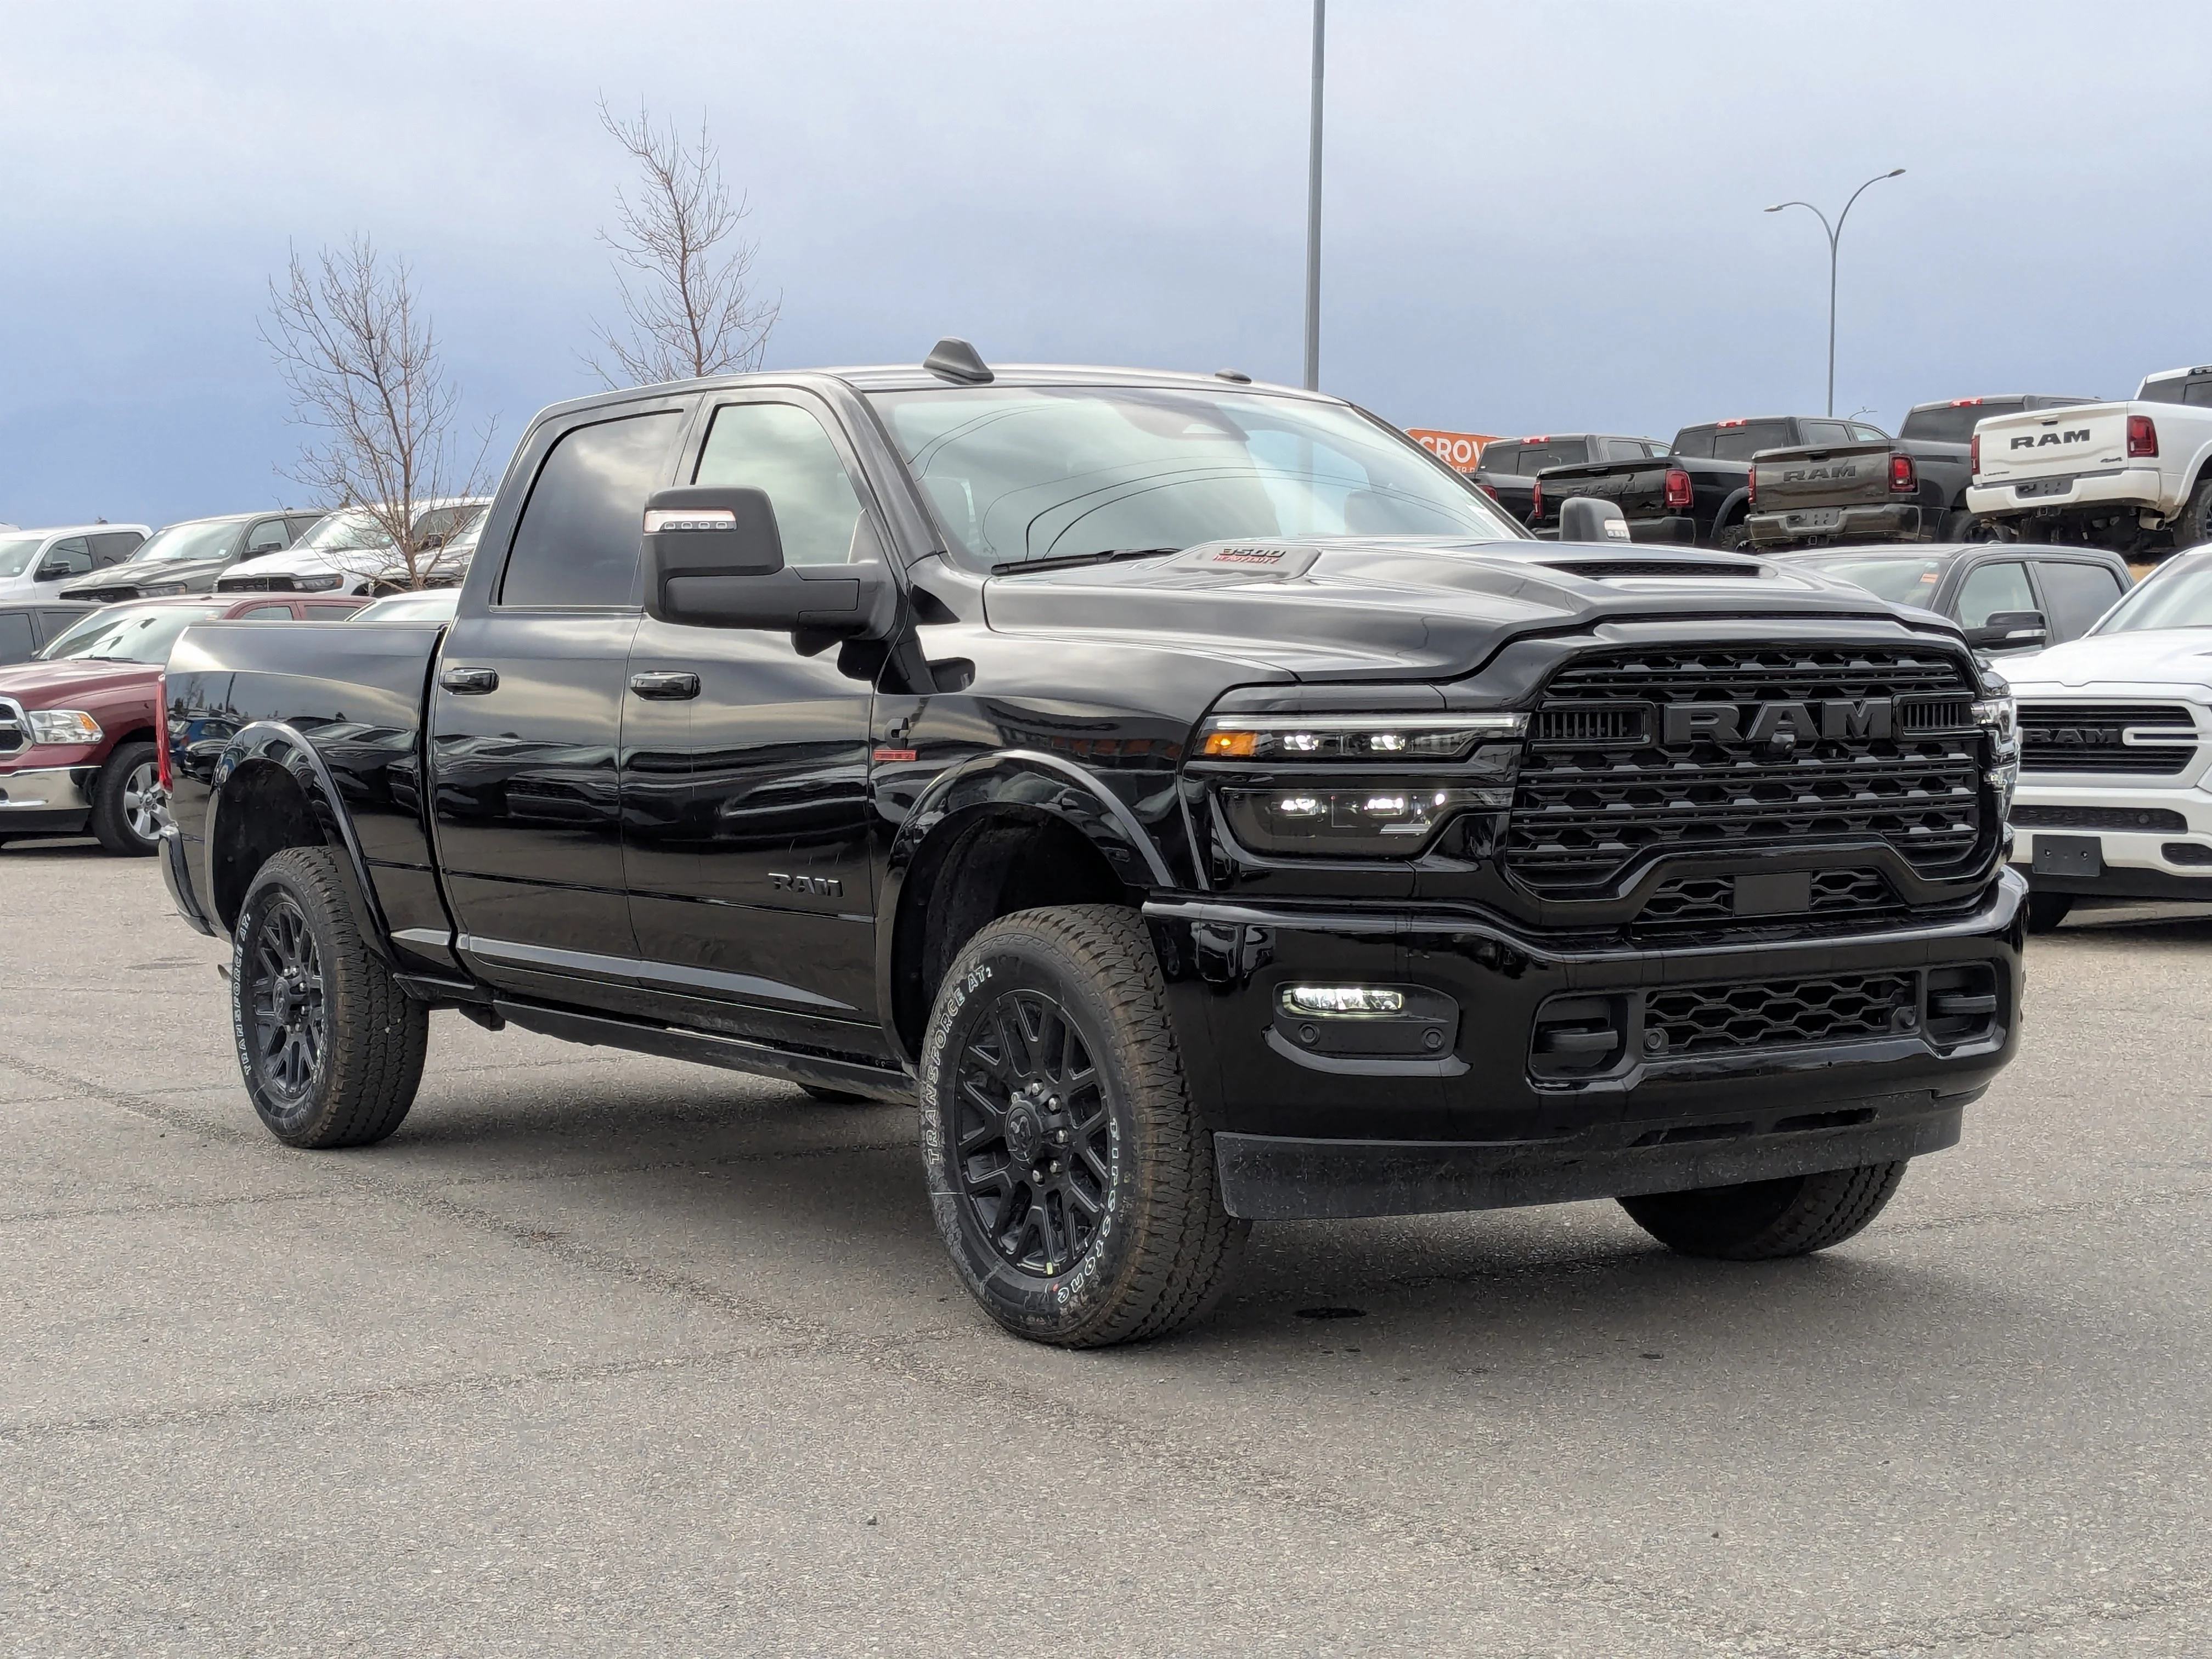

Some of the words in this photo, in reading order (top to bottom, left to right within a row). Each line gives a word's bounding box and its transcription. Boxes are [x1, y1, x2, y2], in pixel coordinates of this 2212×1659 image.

[2010, 429, 2090, 450] RAM
[1783, 465, 1857, 481] RAM
[1664, 698, 1892, 744] RAM
[2023, 728, 2119, 744] RAM
[768, 872, 844, 898] RAM
[925, 986, 966, 1165] TRANSFORCE
[967, 964, 994, 994] AT2
